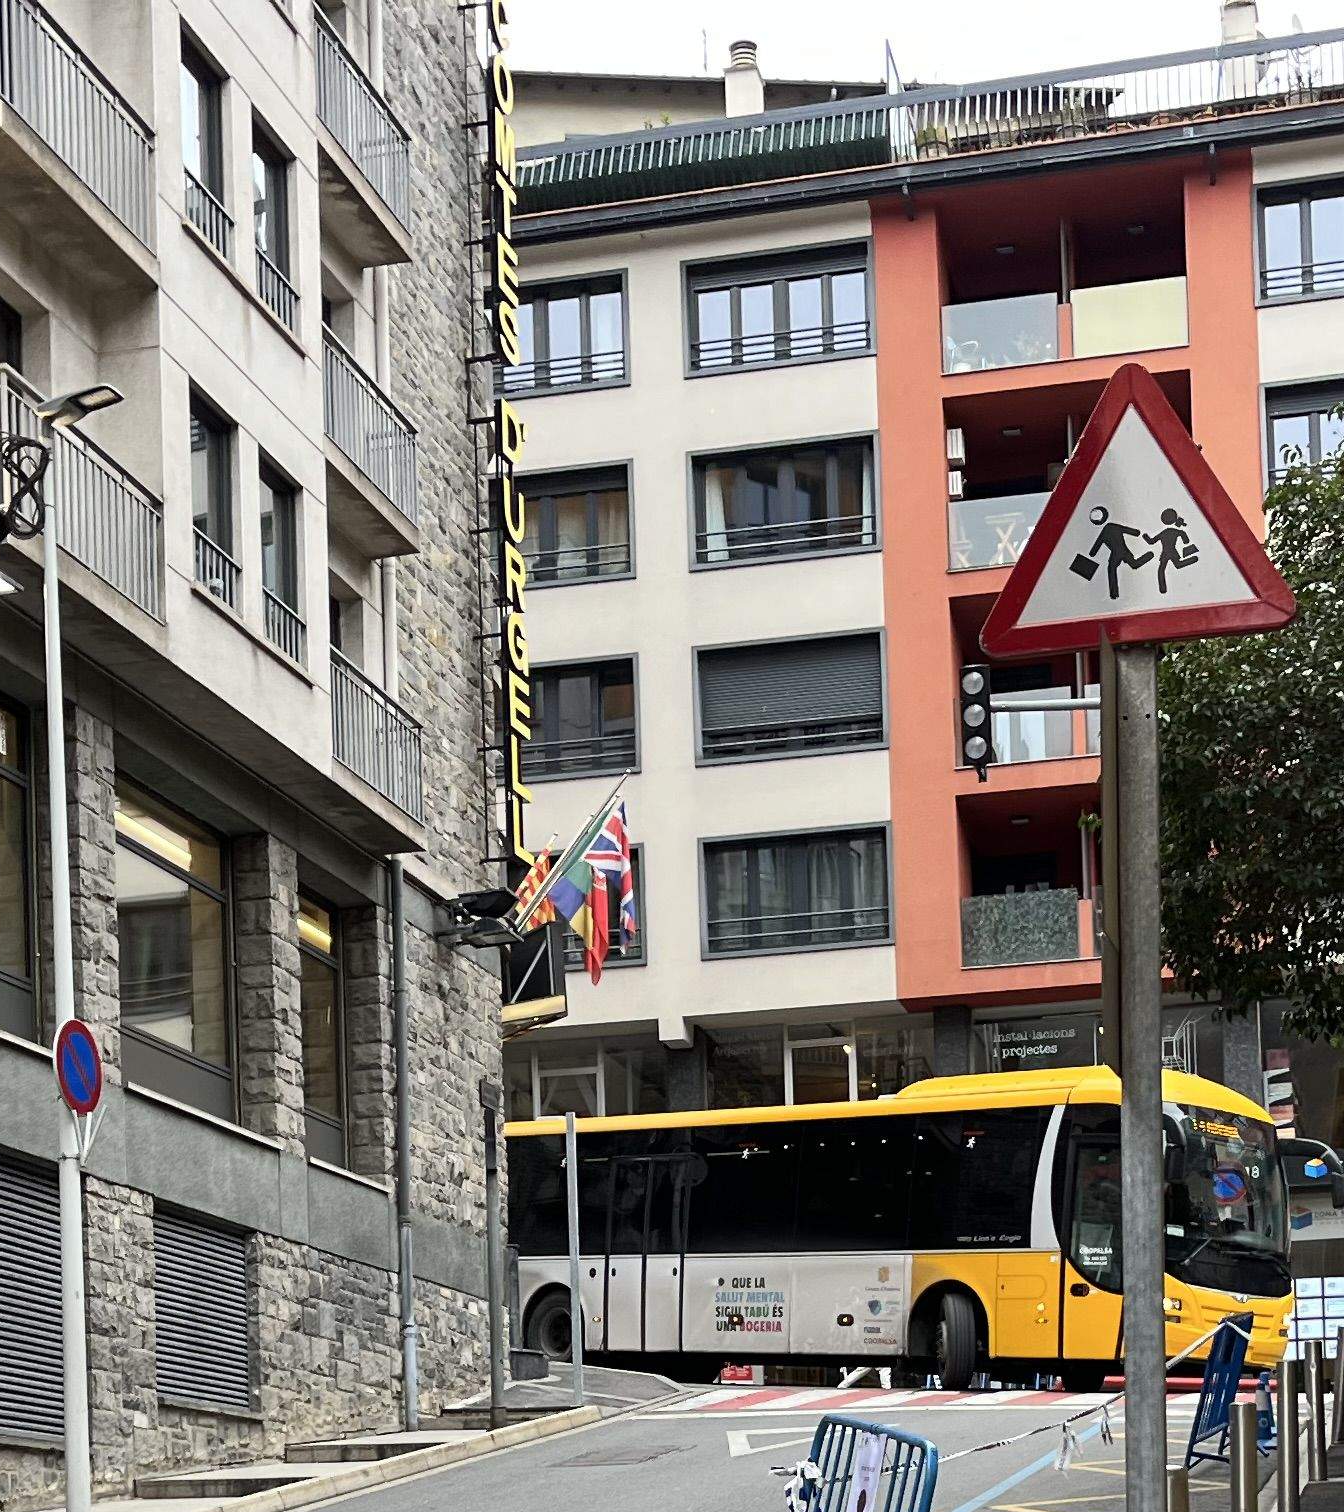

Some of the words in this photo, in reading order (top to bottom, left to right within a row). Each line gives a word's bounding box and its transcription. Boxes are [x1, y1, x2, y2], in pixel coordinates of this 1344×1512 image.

[1002, 1044, 1058, 1058] projectes
[731, 1277, 752, 1289] QUE
[754, 1277, 766, 1289] LA
[715, 1291, 744, 1303] SALUT
[746, 1291, 785, 1303] MENTAL
[744, 1303, 770, 1318] TABÚ
[772, 1303, 784, 1318] ÉS
